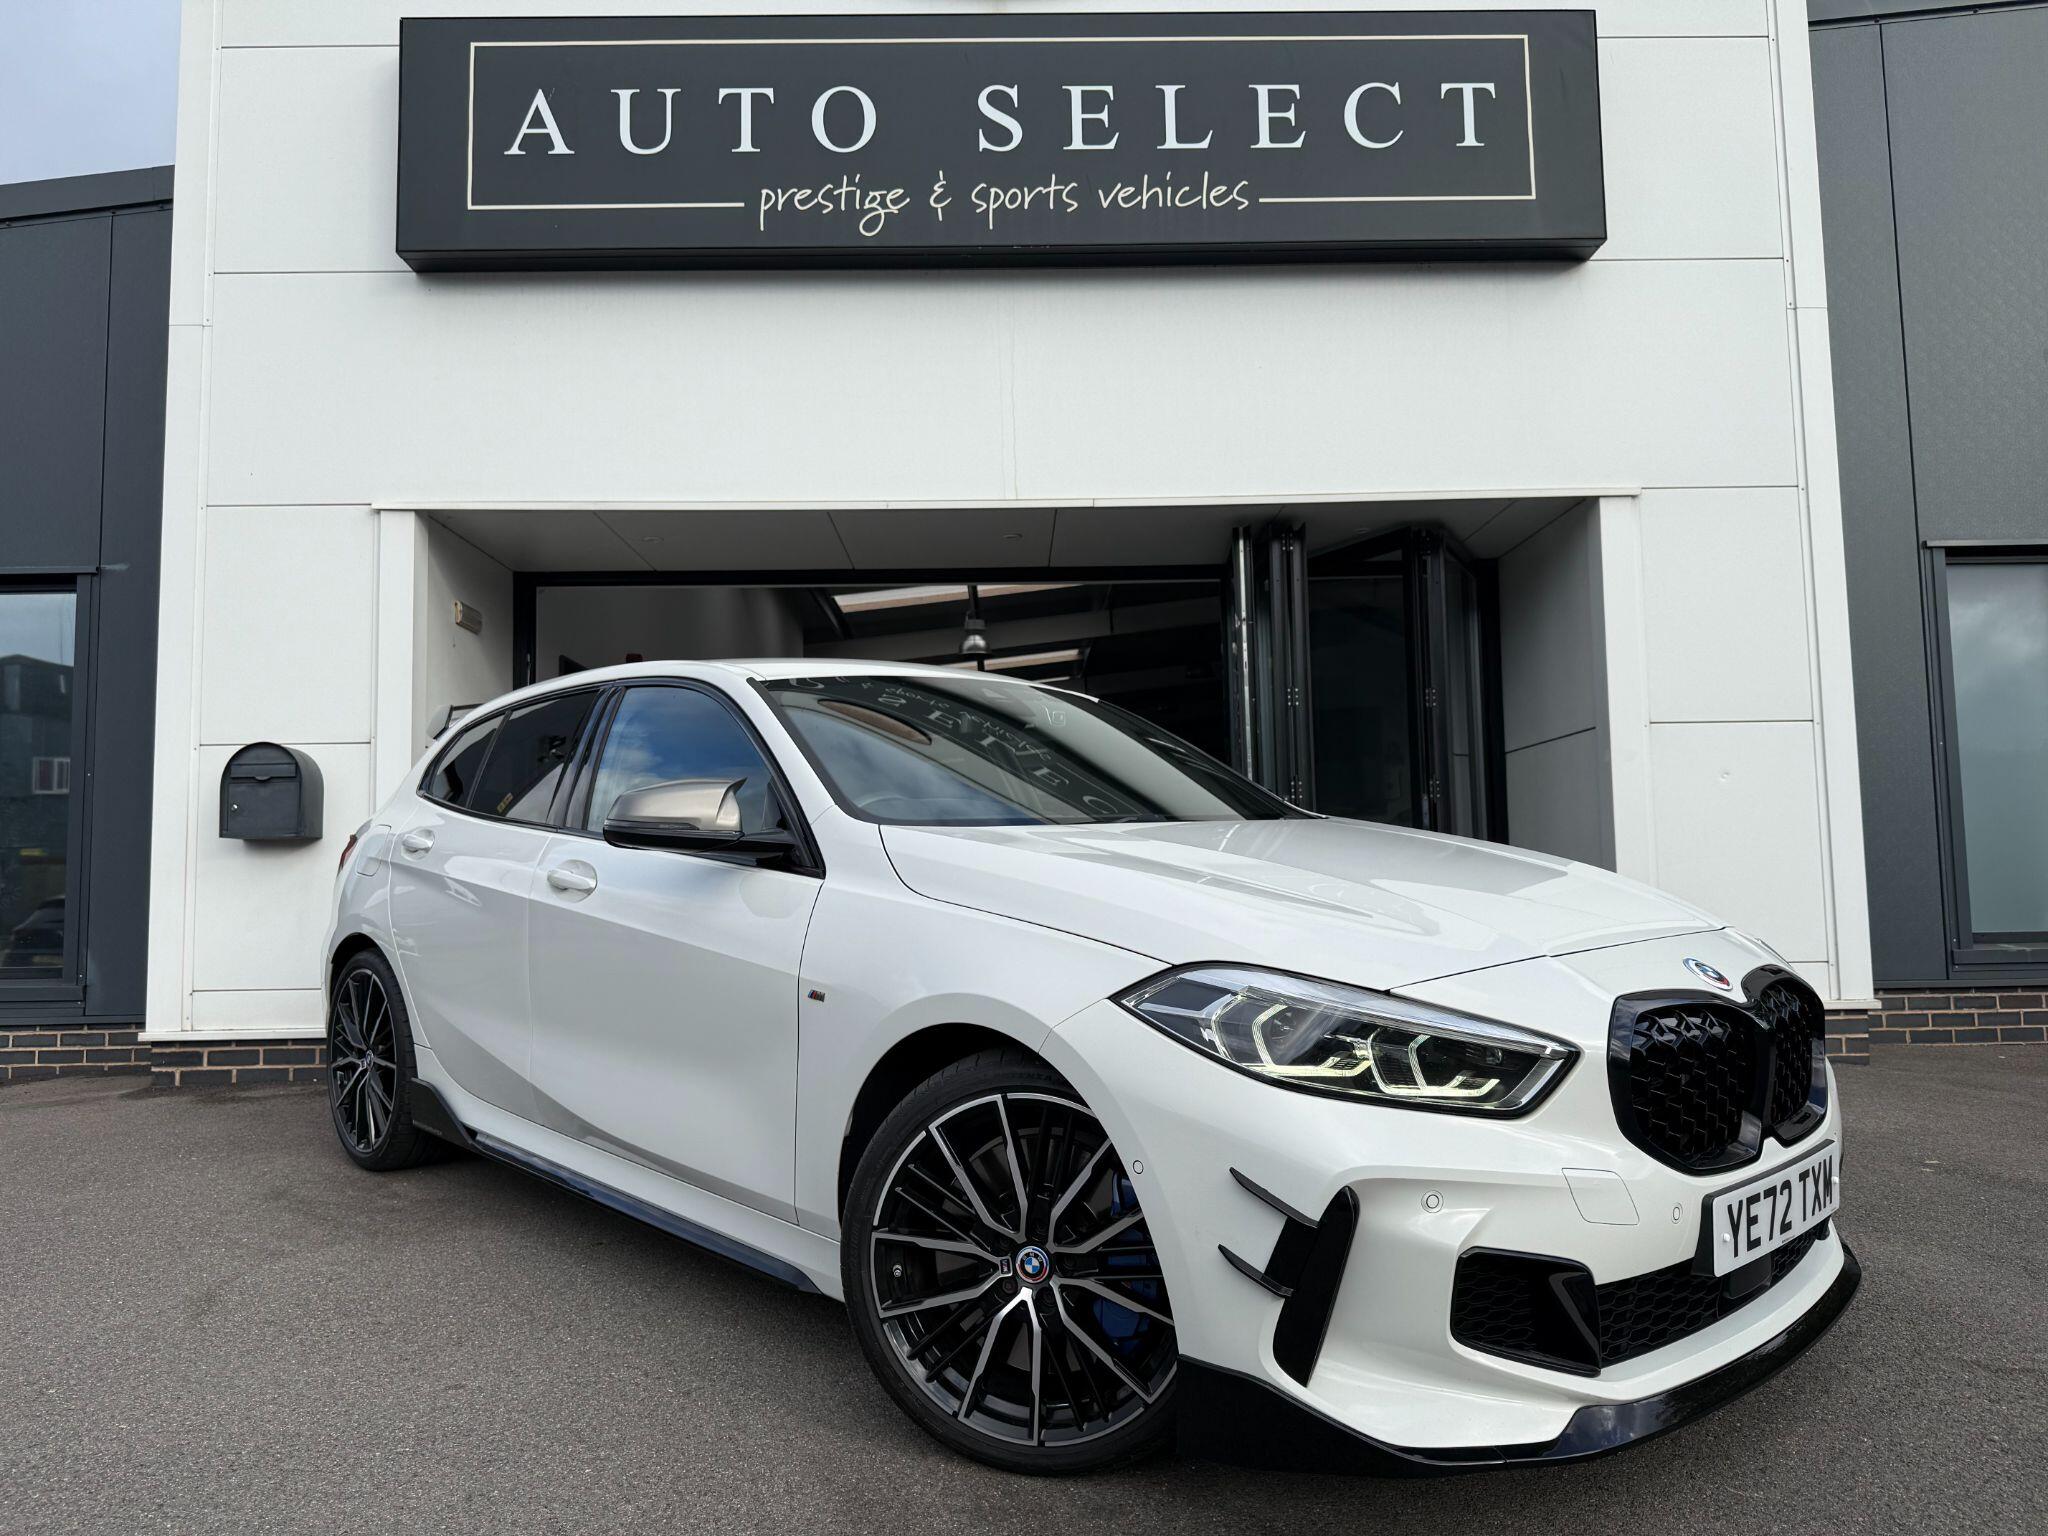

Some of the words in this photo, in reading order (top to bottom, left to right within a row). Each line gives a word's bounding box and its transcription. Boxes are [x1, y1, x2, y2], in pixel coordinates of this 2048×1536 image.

[503, 85, 877, 155] AUTO
[977, 81, 1496, 152] SELECT
[759, 173, 911, 237] prestige
[929, 169, 953, 222] &
[971, 173, 1079, 230] sports
[1097, 170, 1249, 211] vehicles
[1727, 1179, 1792, 1258] YE72
[1798, 1154, 1833, 1222] TXM
